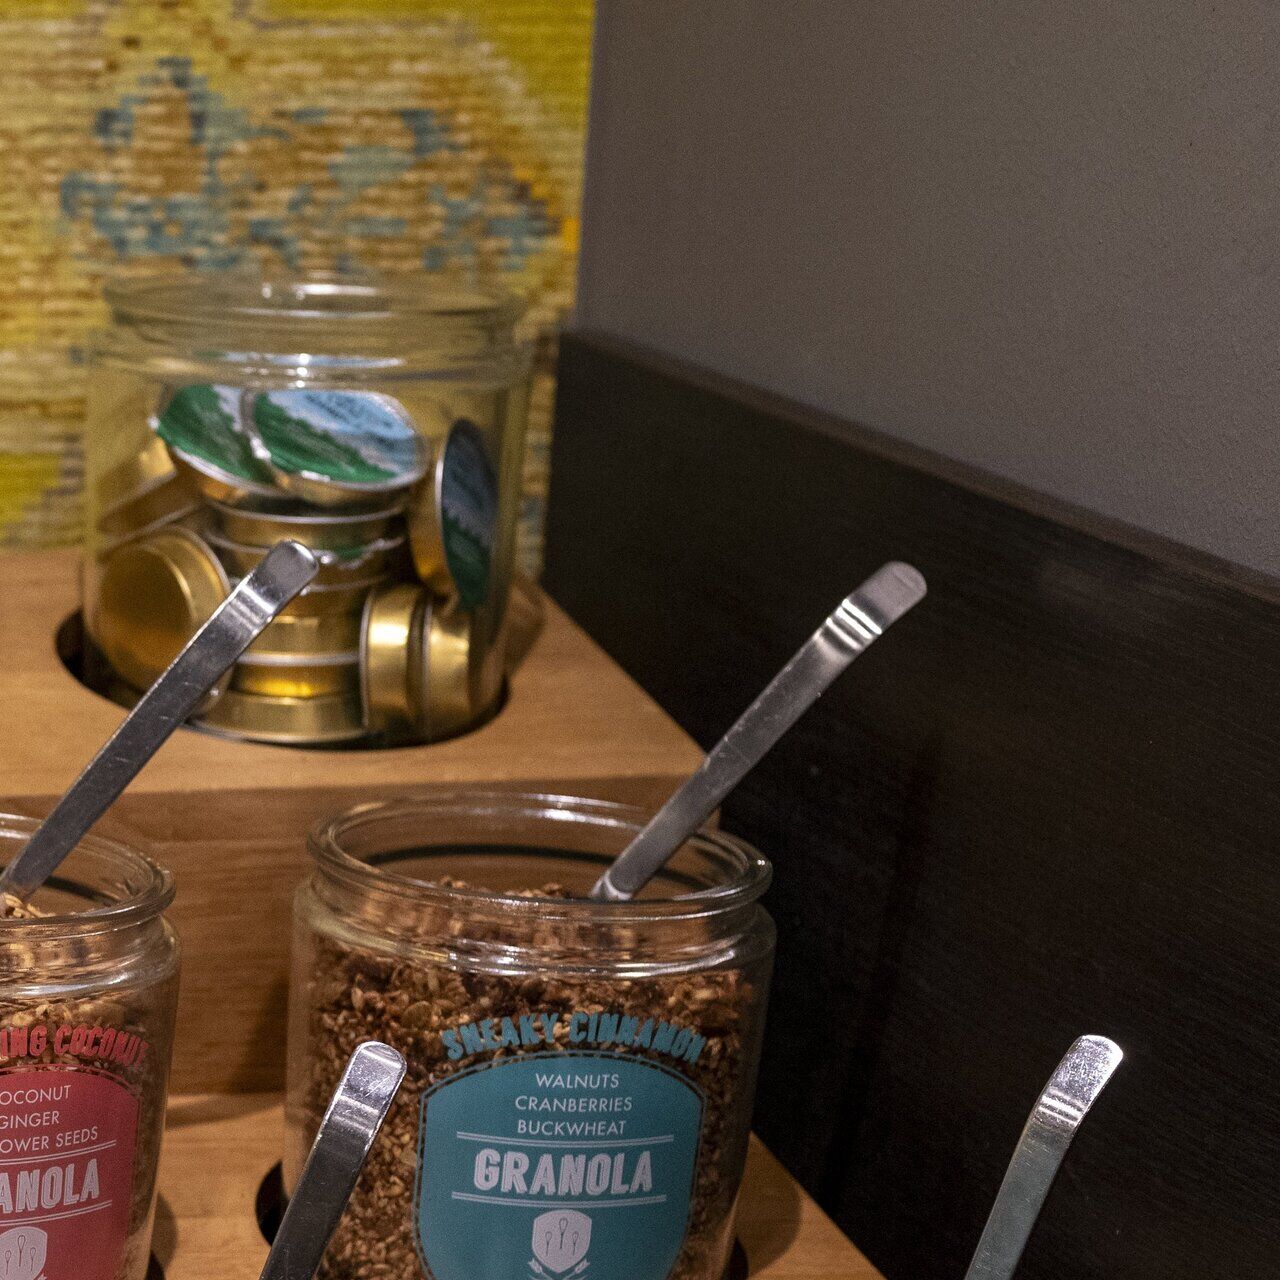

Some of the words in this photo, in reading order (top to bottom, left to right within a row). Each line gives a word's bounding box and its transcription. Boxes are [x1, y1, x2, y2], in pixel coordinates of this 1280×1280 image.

[54, 1024, 150, 1069] COCONUT
[441, 1012, 560, 1061] SNEAKY
[569, 1012, 707, 1064] CINNAMON
[536, 1073, 620, 1089] WALNUTS
[515, 1095, 633, 1112] CRANBERRIES
[55, 1126, 99, 1147] SEEDS
[517, 1119, 626, 1136] BUCKWHEAT
[473, 1148, 653, 1196] GRANOLA
